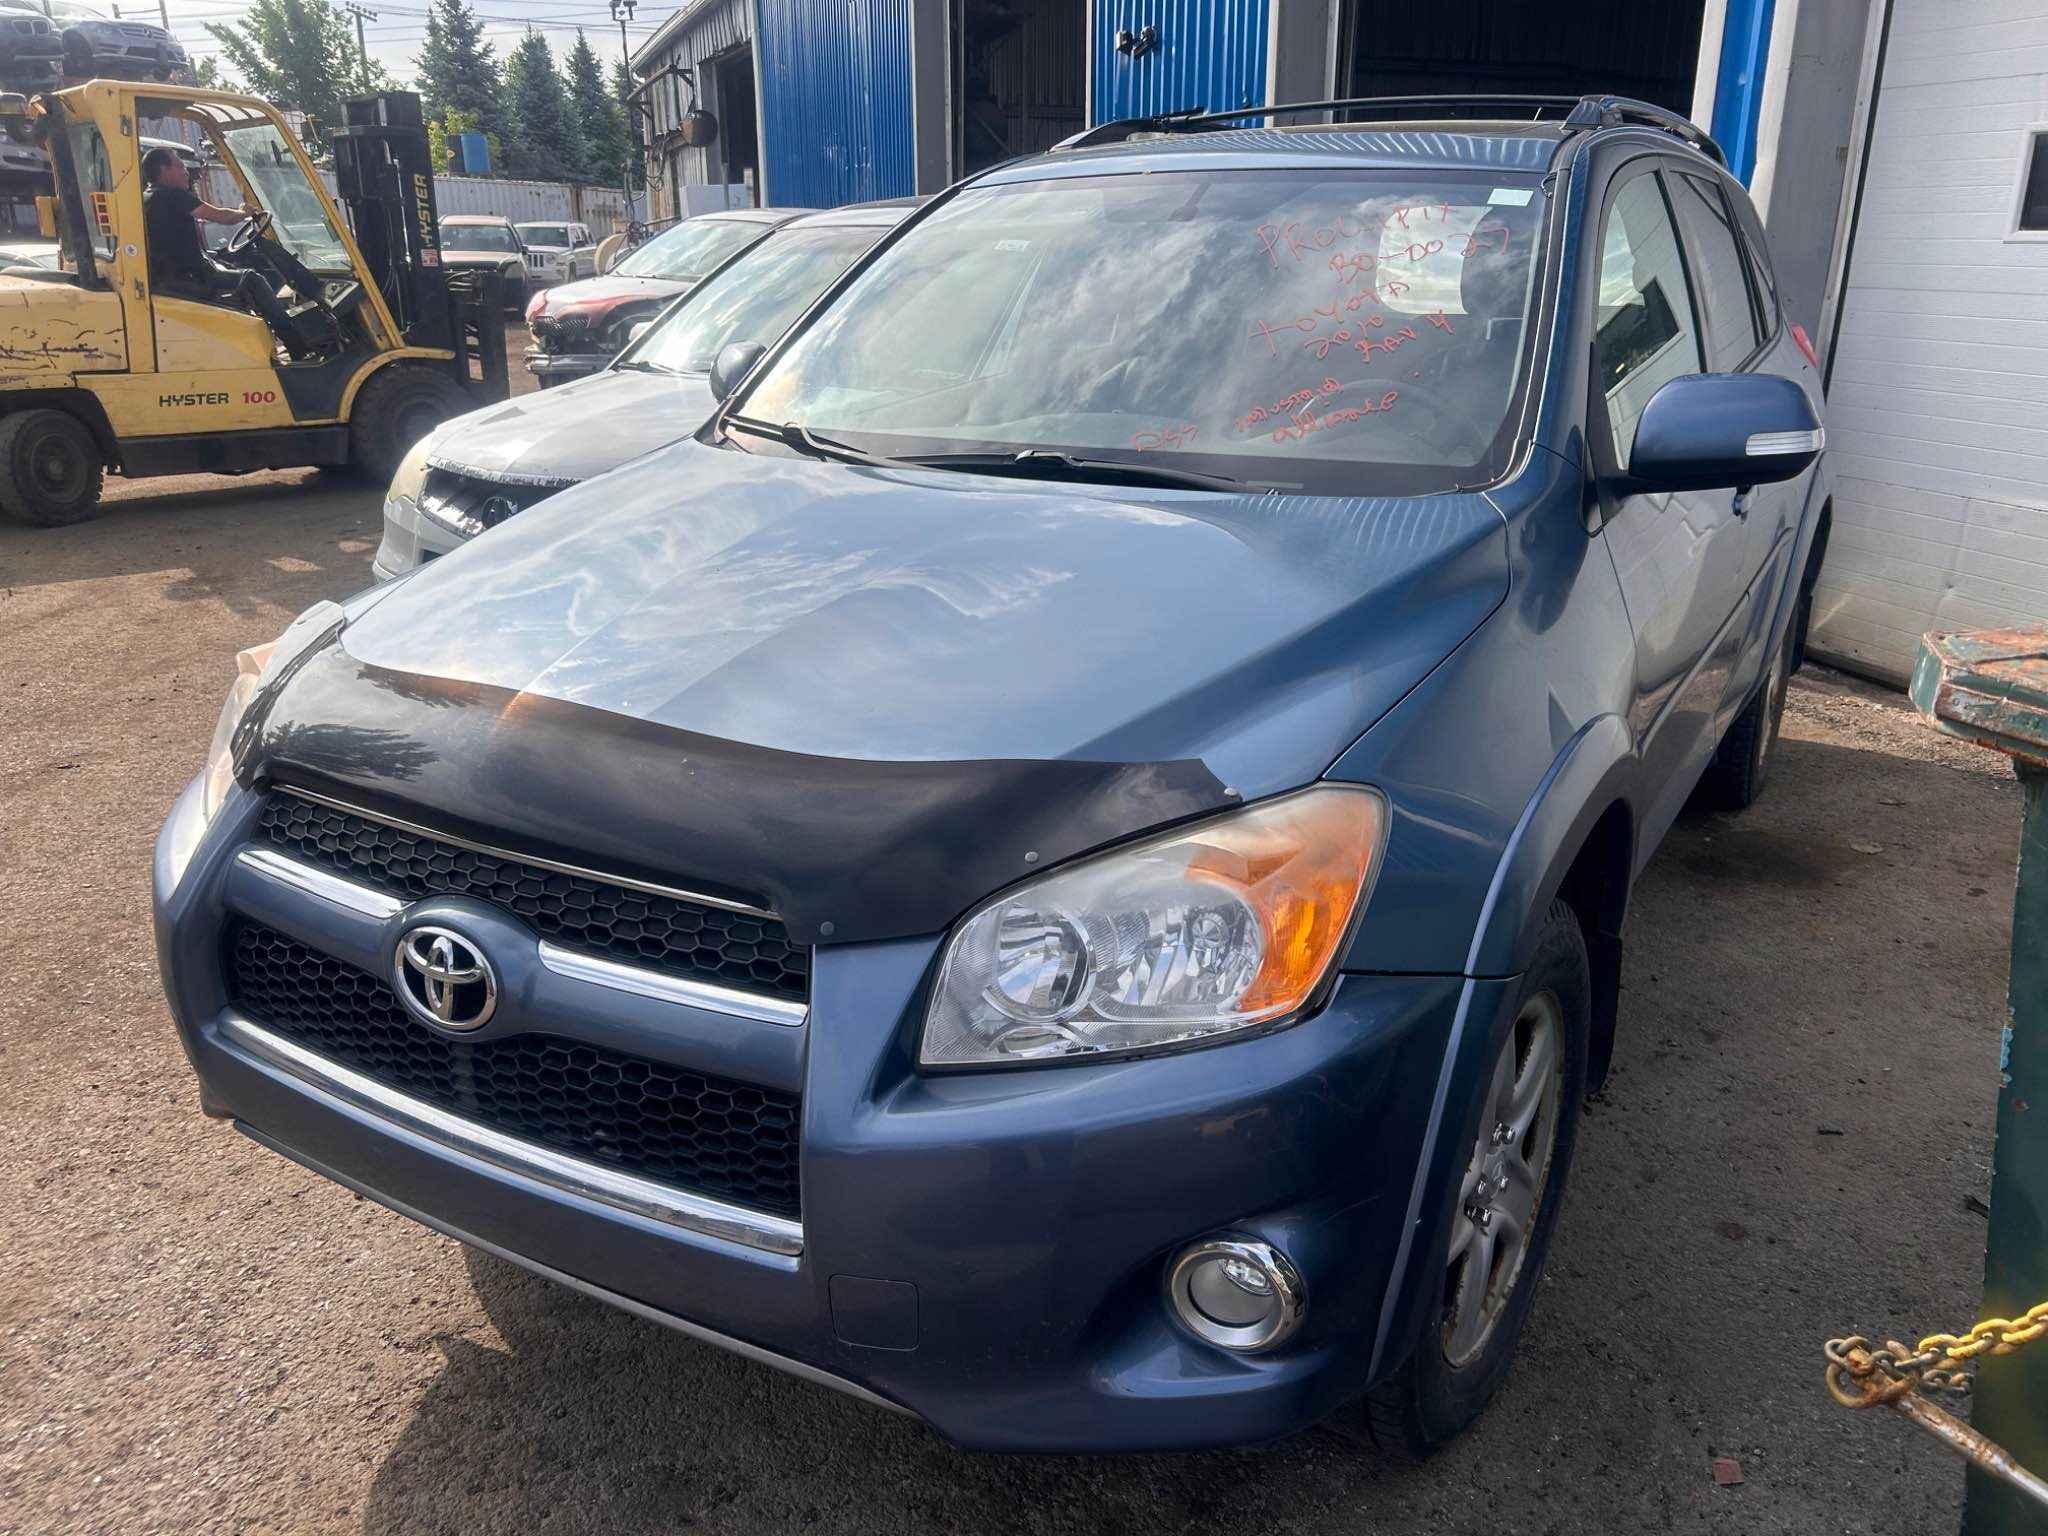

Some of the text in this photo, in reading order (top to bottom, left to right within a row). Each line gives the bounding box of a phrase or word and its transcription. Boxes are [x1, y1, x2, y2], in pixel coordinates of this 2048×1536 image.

[413, 172, 434, 248] HYSTER
[159, 391, 276, 407] HYSTER 100
